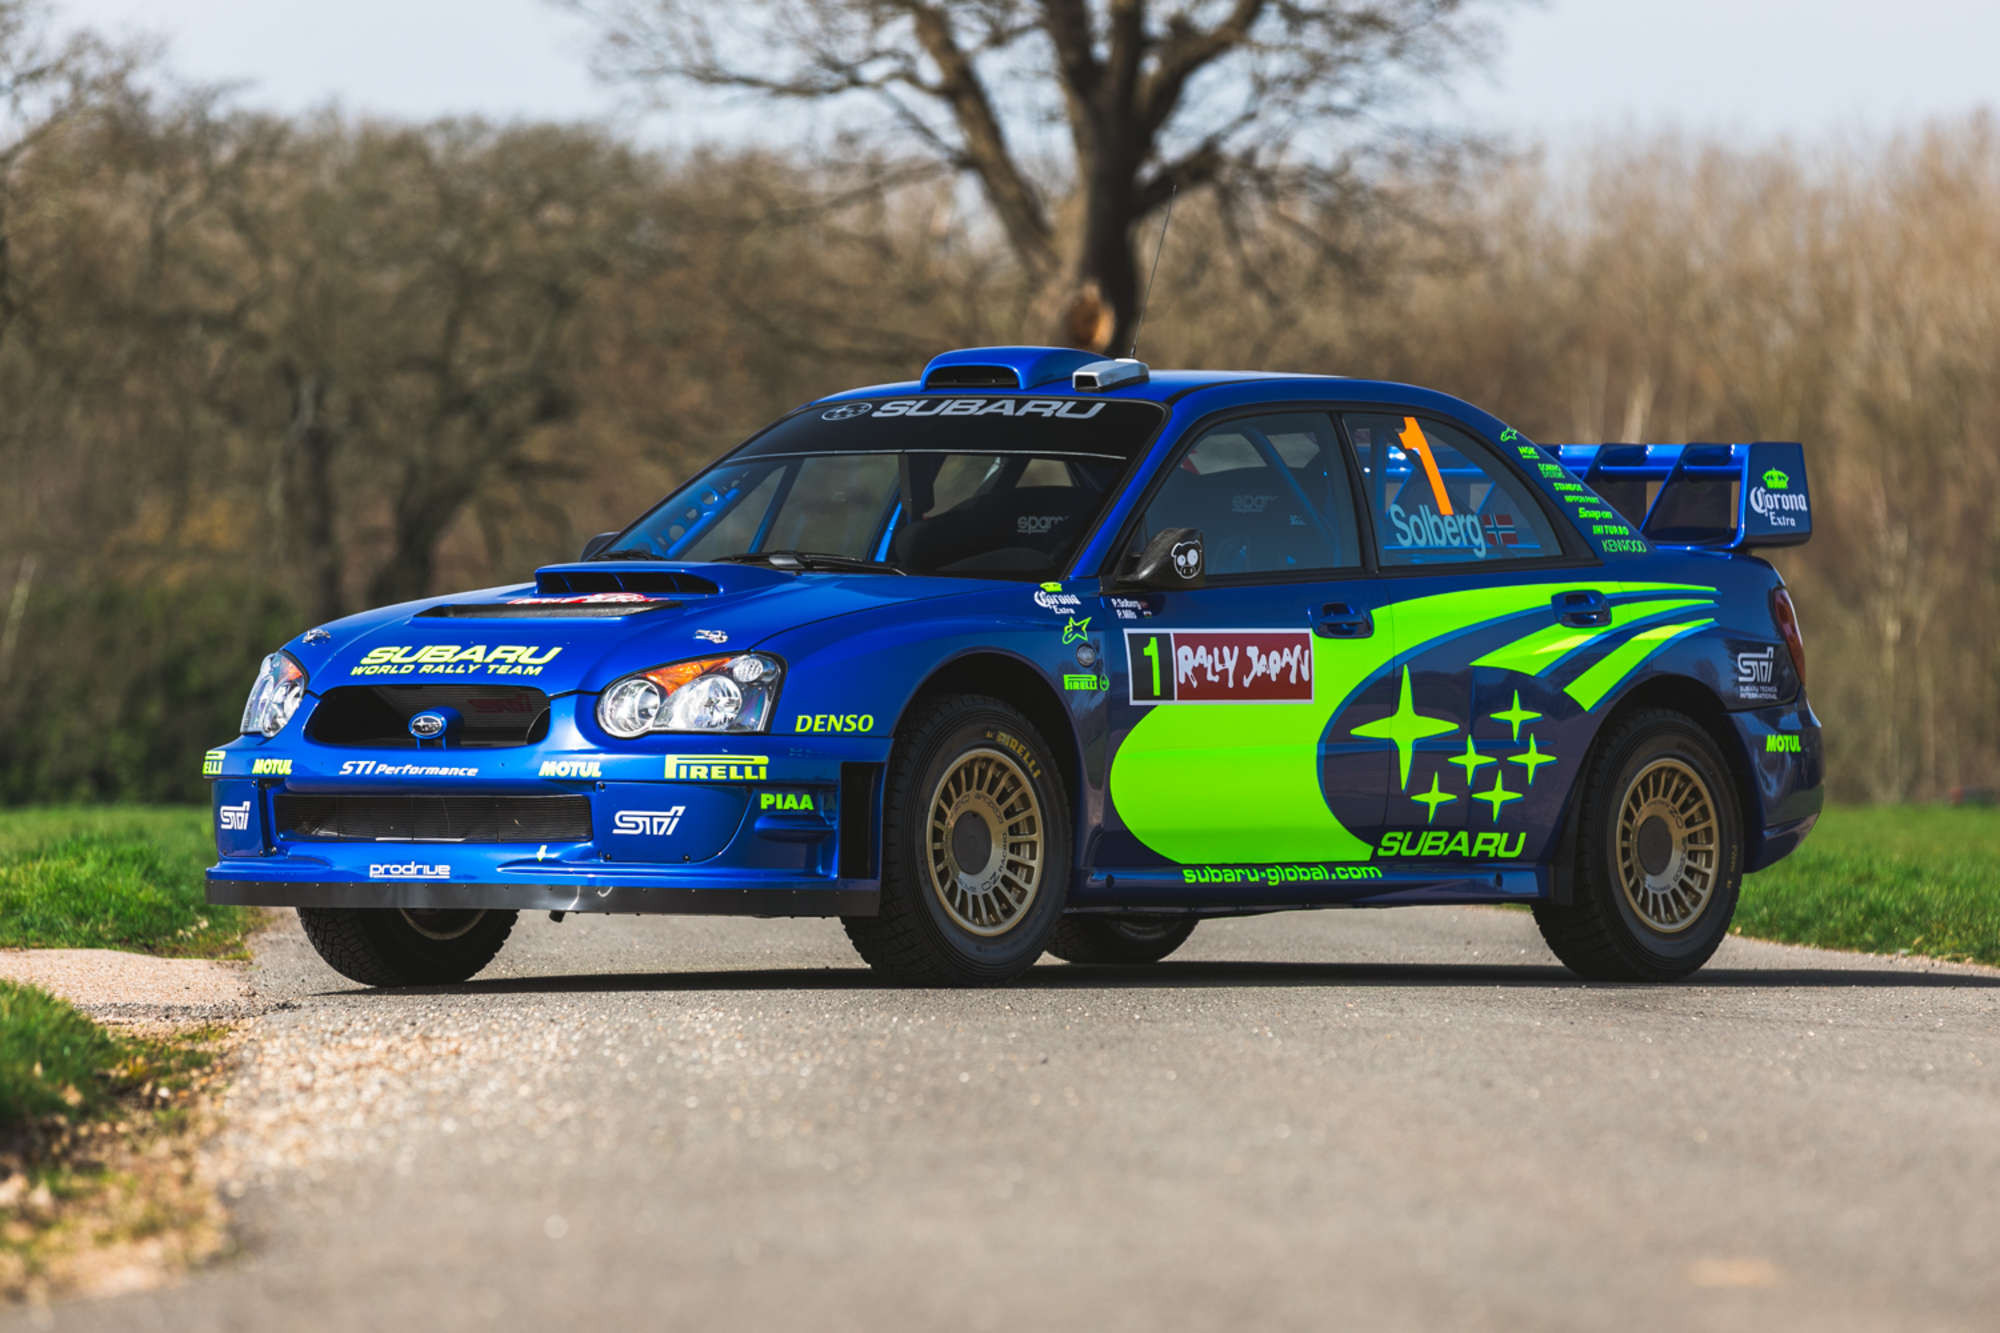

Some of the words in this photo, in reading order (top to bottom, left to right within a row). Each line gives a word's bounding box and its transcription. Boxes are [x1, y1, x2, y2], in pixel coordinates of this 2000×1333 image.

[871, 399, 1106, 419] SUBARU
[1398, 416, 1454, 515] 1
[1750, 485, 1808, 517] Corona
[1769, 511, 1797, 527] Extra
[1389, 504, 1487, 559] Solberg
[1601, 539, 1647, 553] KENWOOD
[1034, 590, 1081, 609] Corona
[360, 645, 563, 665] SUBARU
[350, 664, 415, 676] WORLD
[418, 664, 481, 674] RALLY
[487, 665, 545, 677] TEAM
[1143, 637, 1160, 696] 1
[795, 714, 874, 732] DENSO
[1765, 734, 1801, 752] MOTUL
[252, 758, 293, 775] MOTUL
[339, 760, 376, 775] STI
[375, 764, 479, 777] Performance
[539, 761, 601, 777] MOTUL
[664, 754, 770, 780] PIRELLI
[760, 793, 815, 810] PIAA
[1377, 830, 1527, 858] SUBARU
[370, 861, 451, 879] prodrive
[1182, 864, 1383, 886] subaru-global.com
